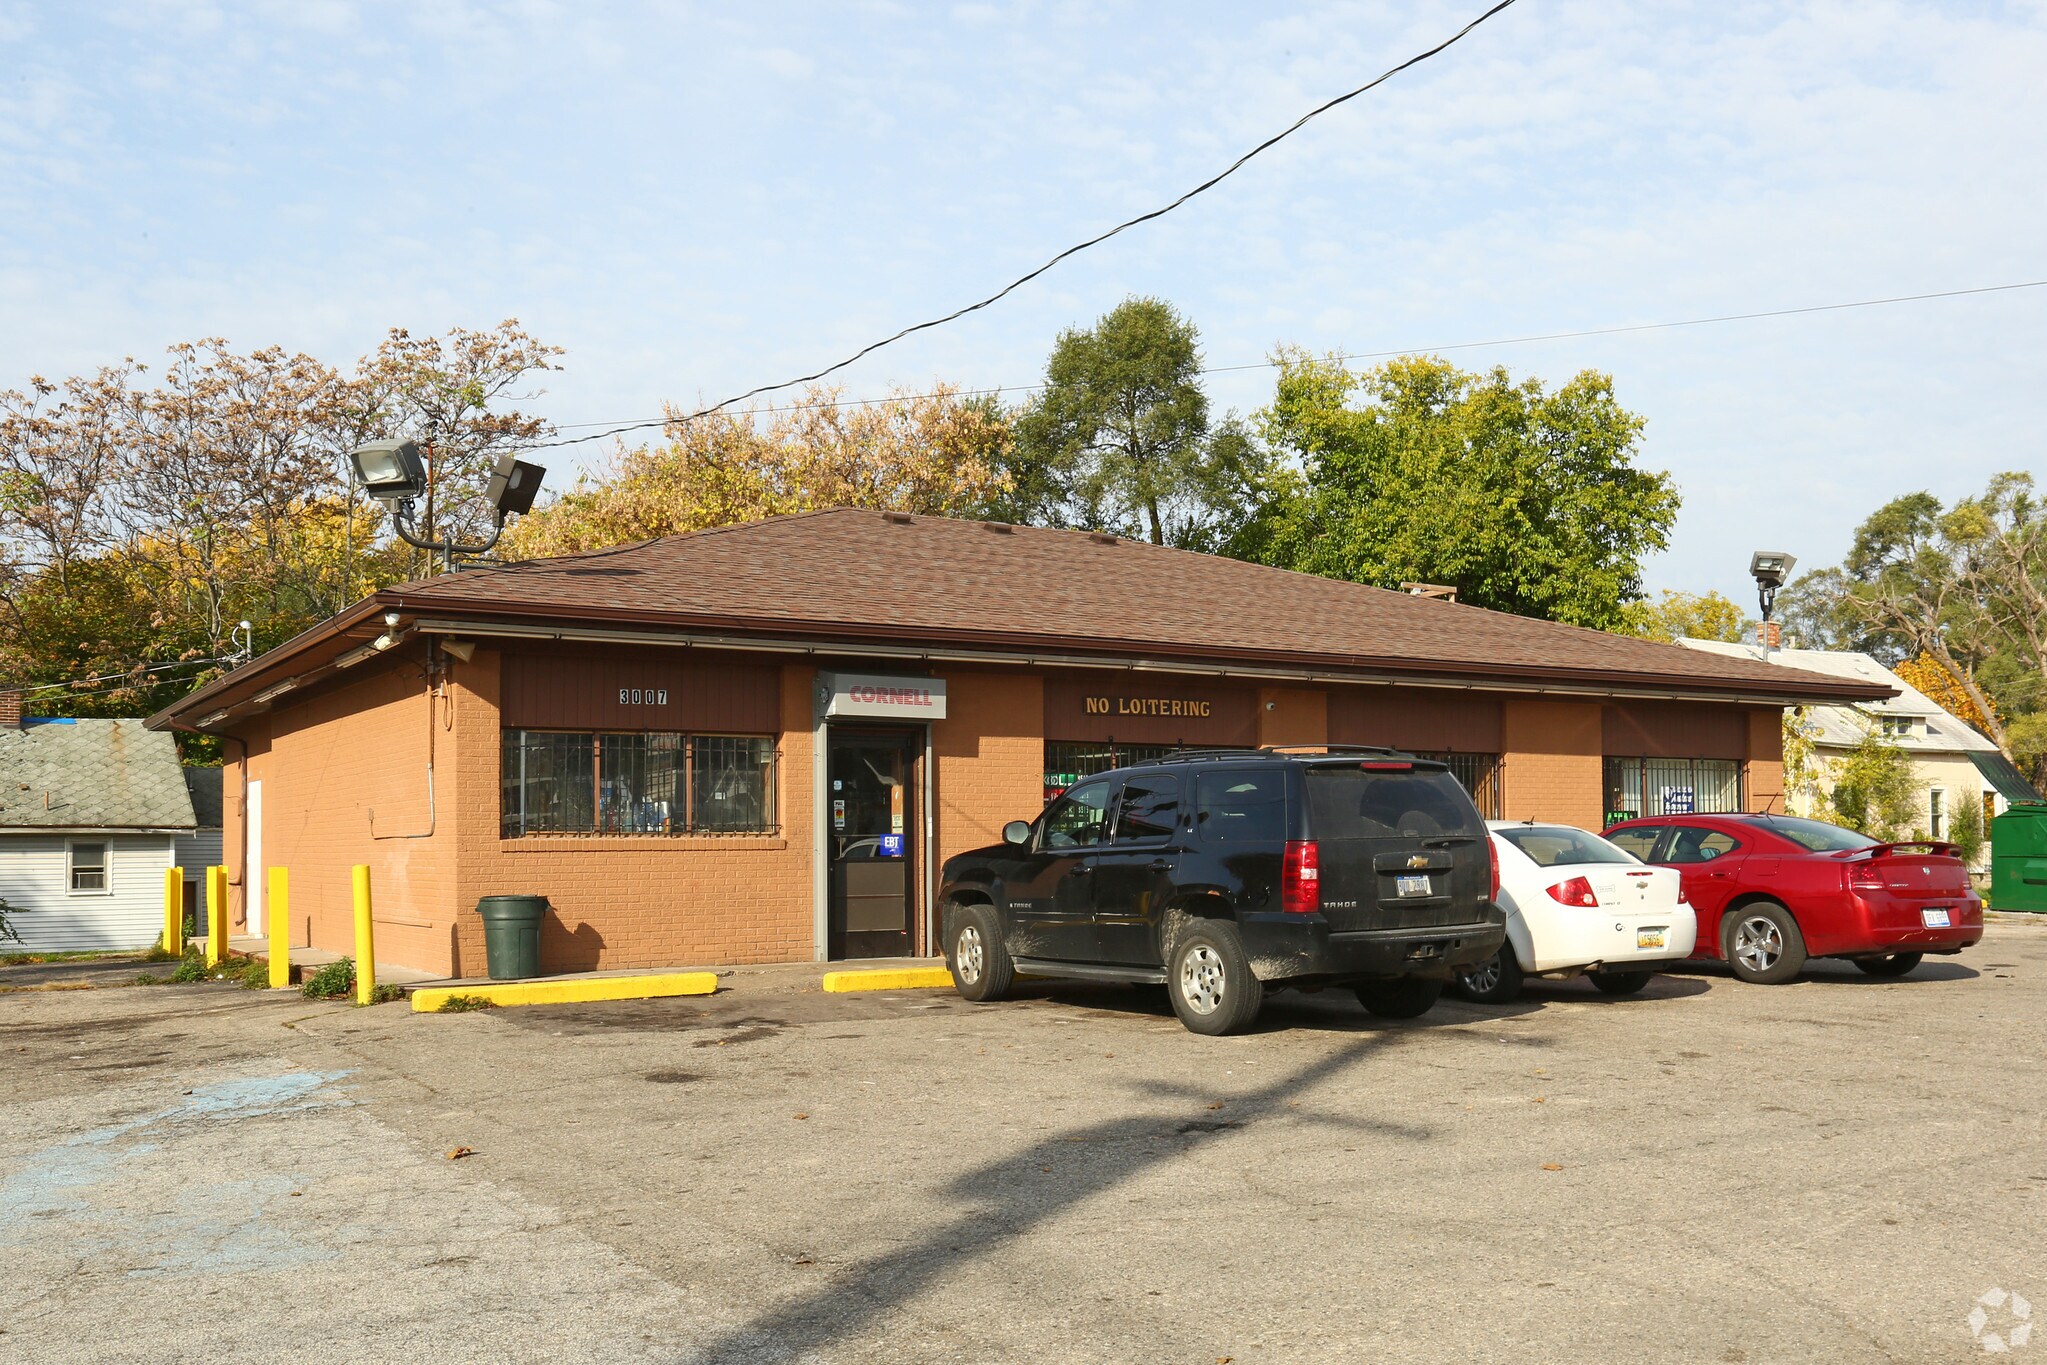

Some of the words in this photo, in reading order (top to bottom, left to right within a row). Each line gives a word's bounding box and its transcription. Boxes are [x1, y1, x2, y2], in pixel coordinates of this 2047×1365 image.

[620, 689, 667, 704] 3007
[850, 685, 933, 707] CORNELL
[1086, 697, 1110, 713] NO
[1119, 698, 1210, 717] LOITERING
[884, 836, 900, 849] EBT
